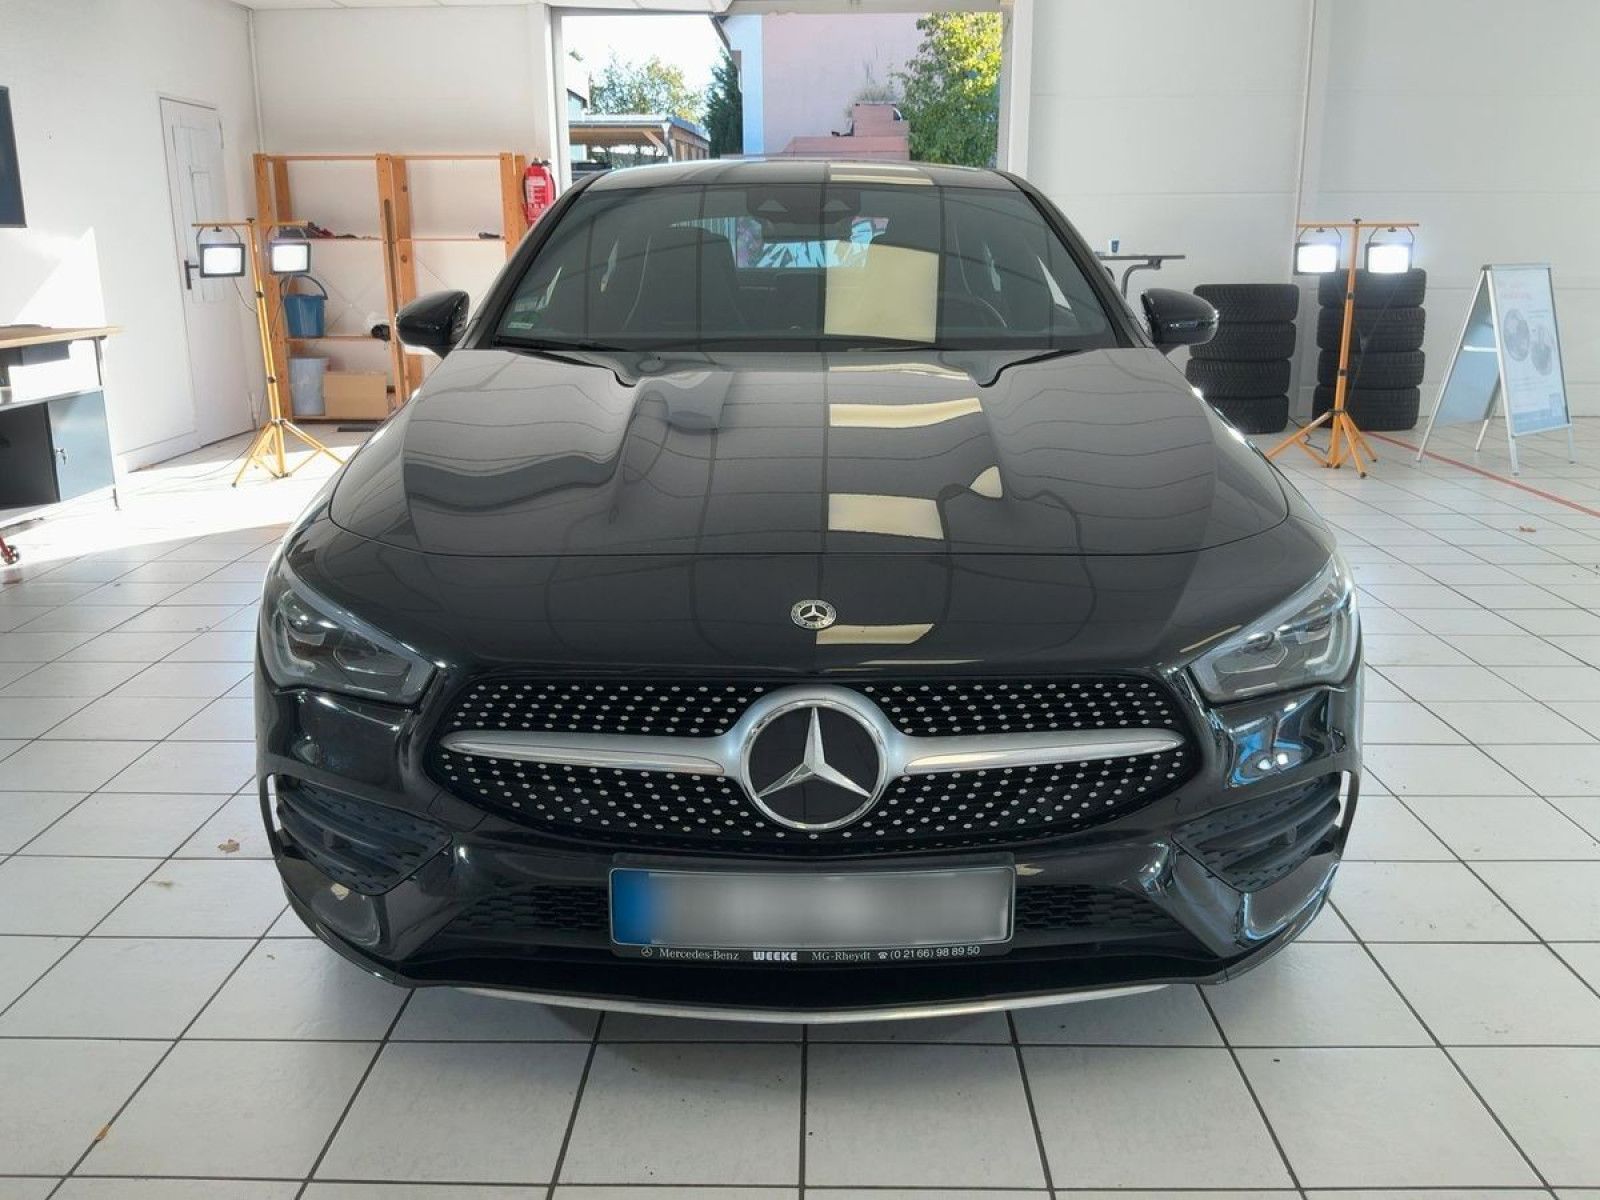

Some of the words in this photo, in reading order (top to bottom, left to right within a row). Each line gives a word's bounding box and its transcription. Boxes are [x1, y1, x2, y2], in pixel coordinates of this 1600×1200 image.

[659, 949, 740, 961] Mercedes-Benz
[811, 951, 872, 962] MG-Rheydt
[967, 945, 981, 955] 50
